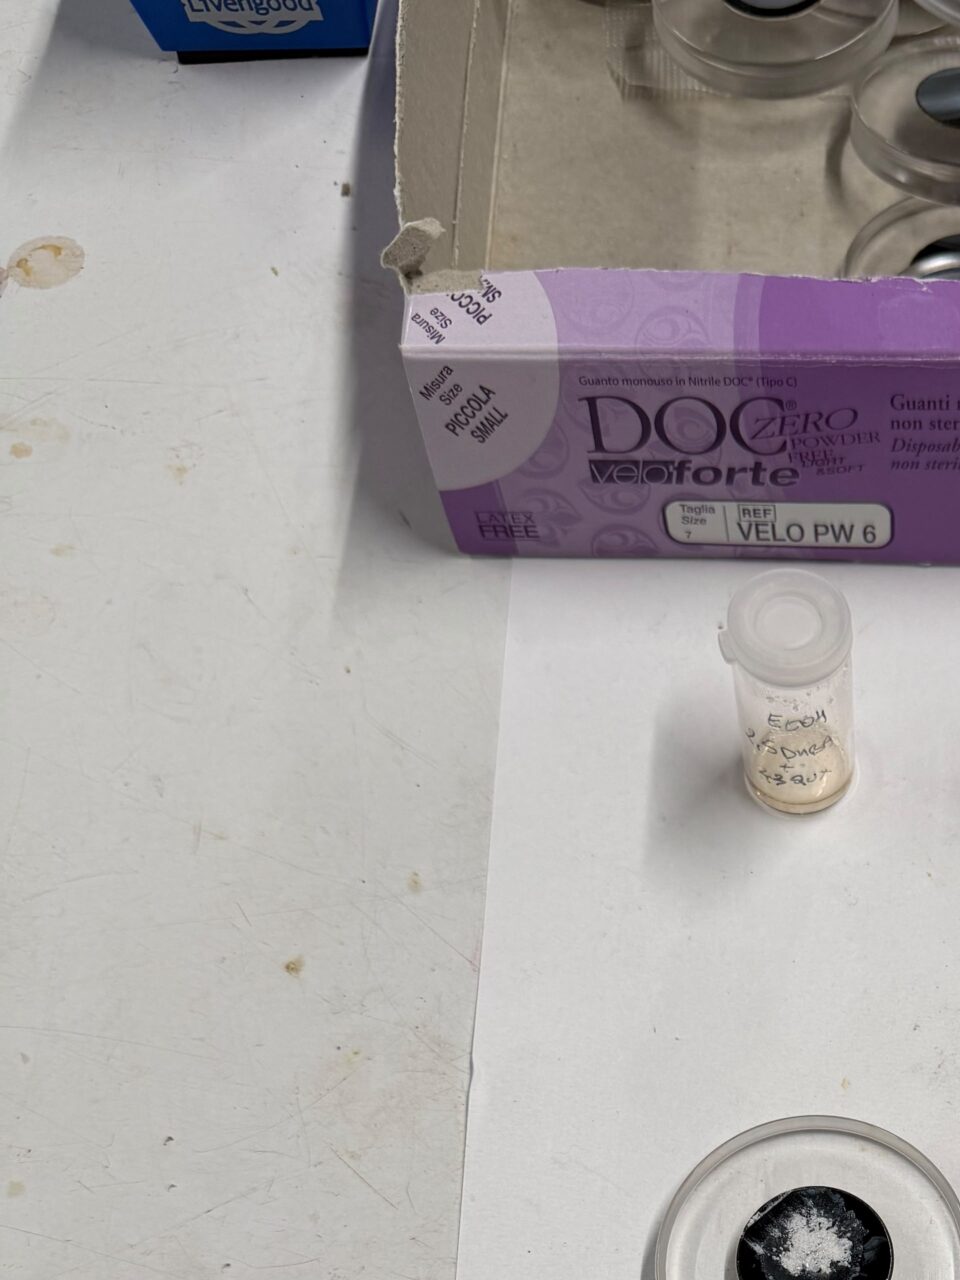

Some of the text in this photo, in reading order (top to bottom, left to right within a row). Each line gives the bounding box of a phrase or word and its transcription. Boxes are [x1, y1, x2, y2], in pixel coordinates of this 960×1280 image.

[188, 0, 315, 16] Livengood
[430, 307, 453, 329] Size
[411, 313, 446, 345] Misura
[419, 365, 454, 401] Misura
[578, 376, 620, 387] Guanto
[622, 377, 673, 387] monouso
[675, 376, 686, 387] in
[688, 376, 721, 387] Nitrile
[756, 376, 784, 388] (Tipo
[785, 376, 798, 388] C)
[439, 383, 463, 406] Size
[890, 394, 950, 412] Guanti
[445, 384, 496, 437] PICCOLA
[470, 406, 509, 444] SMALL
[750, 407, 858, 440] ZERO
[890, 418, 923, 431] non
[791, 431, 880, 450] POWDER
[890, 459, 921, 471] non
[475, 511, 535, 524] LATEX
[679, 503, 716, 516] Taglia
[742, 507, 773, 519] REF
[681, 516, 707, 526] Size
[479, 524, 541, 539] FREE
[737, 522, 877, 544] VELO PW 6
